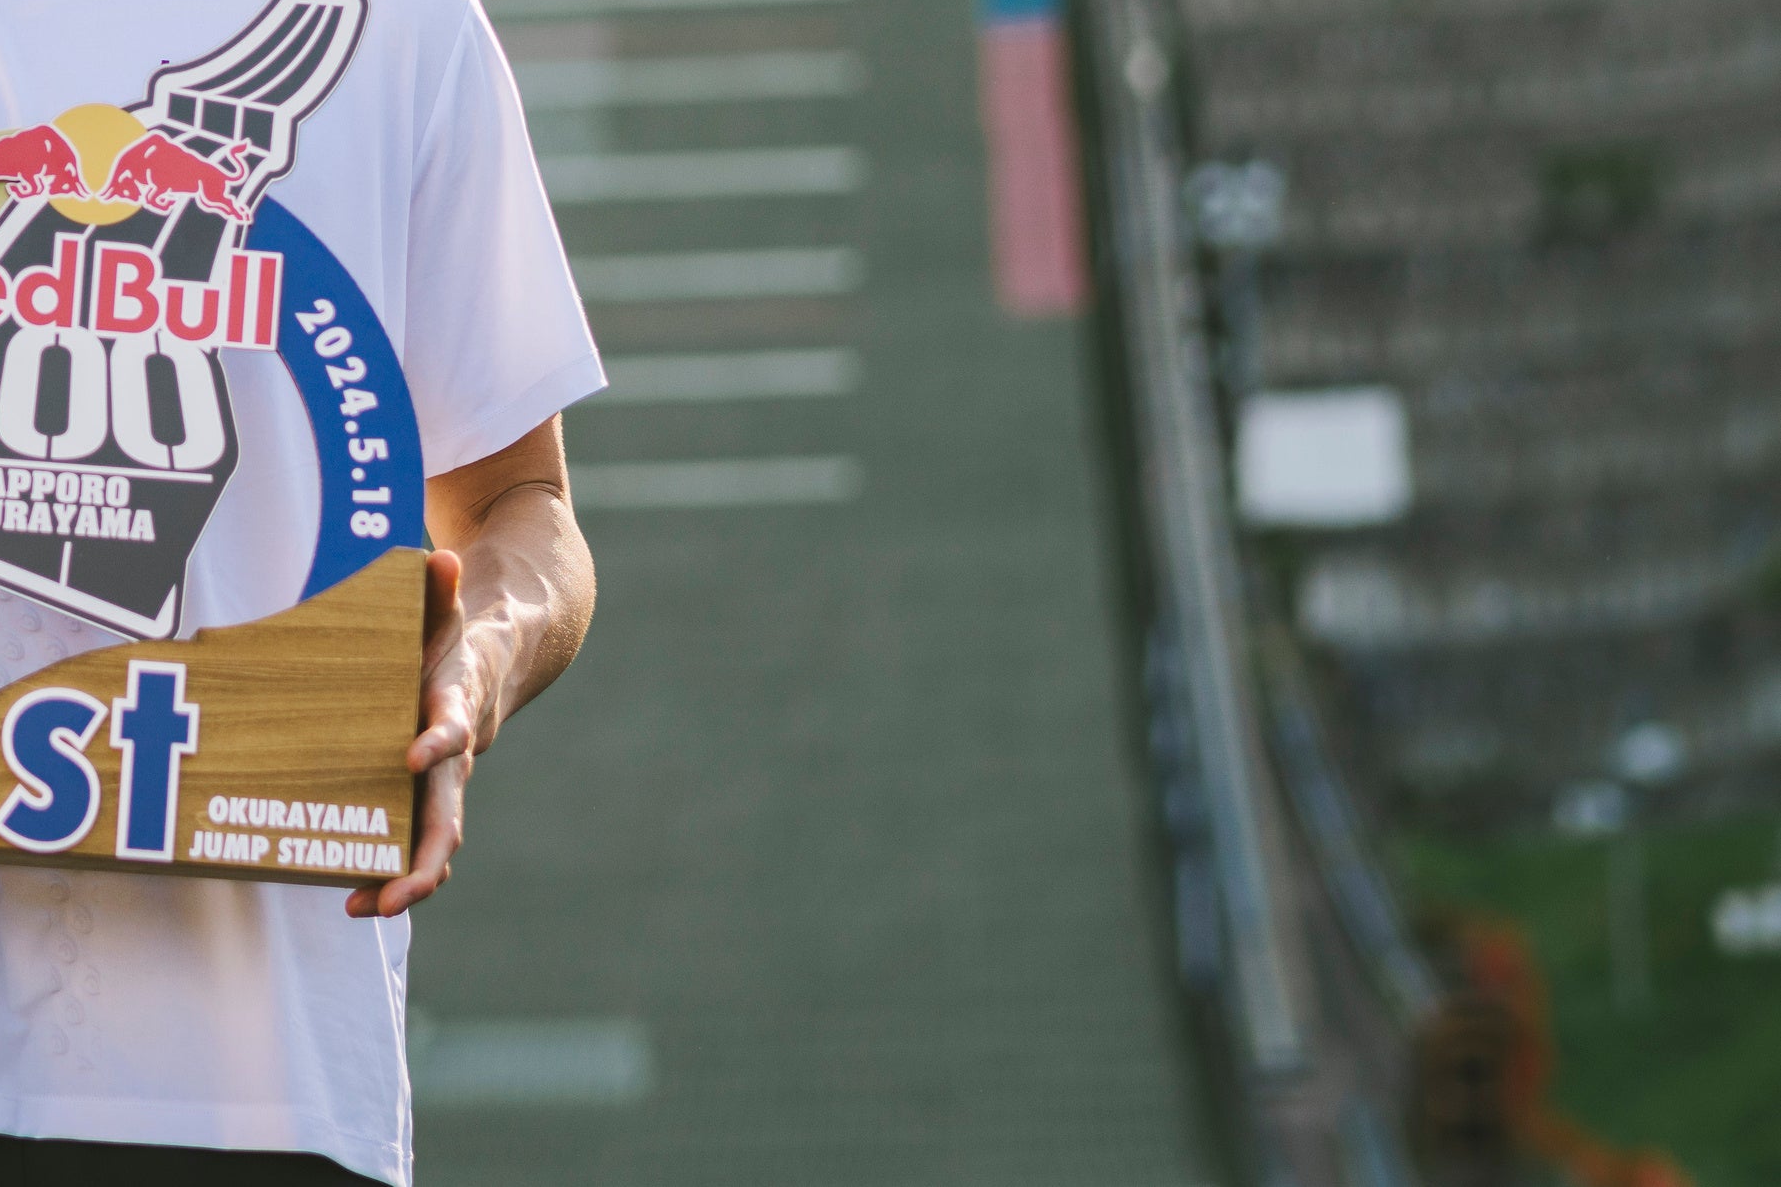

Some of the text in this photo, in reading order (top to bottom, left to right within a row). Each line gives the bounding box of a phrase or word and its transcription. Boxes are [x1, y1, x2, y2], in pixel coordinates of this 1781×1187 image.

[94, 246, 278, 347] Bull
[295, 298, 391, 538] 2024.5.18
[189, 830, 401, 873] JUMP STADIUM
[208, 795, 389, 836] OKURAYAMA
